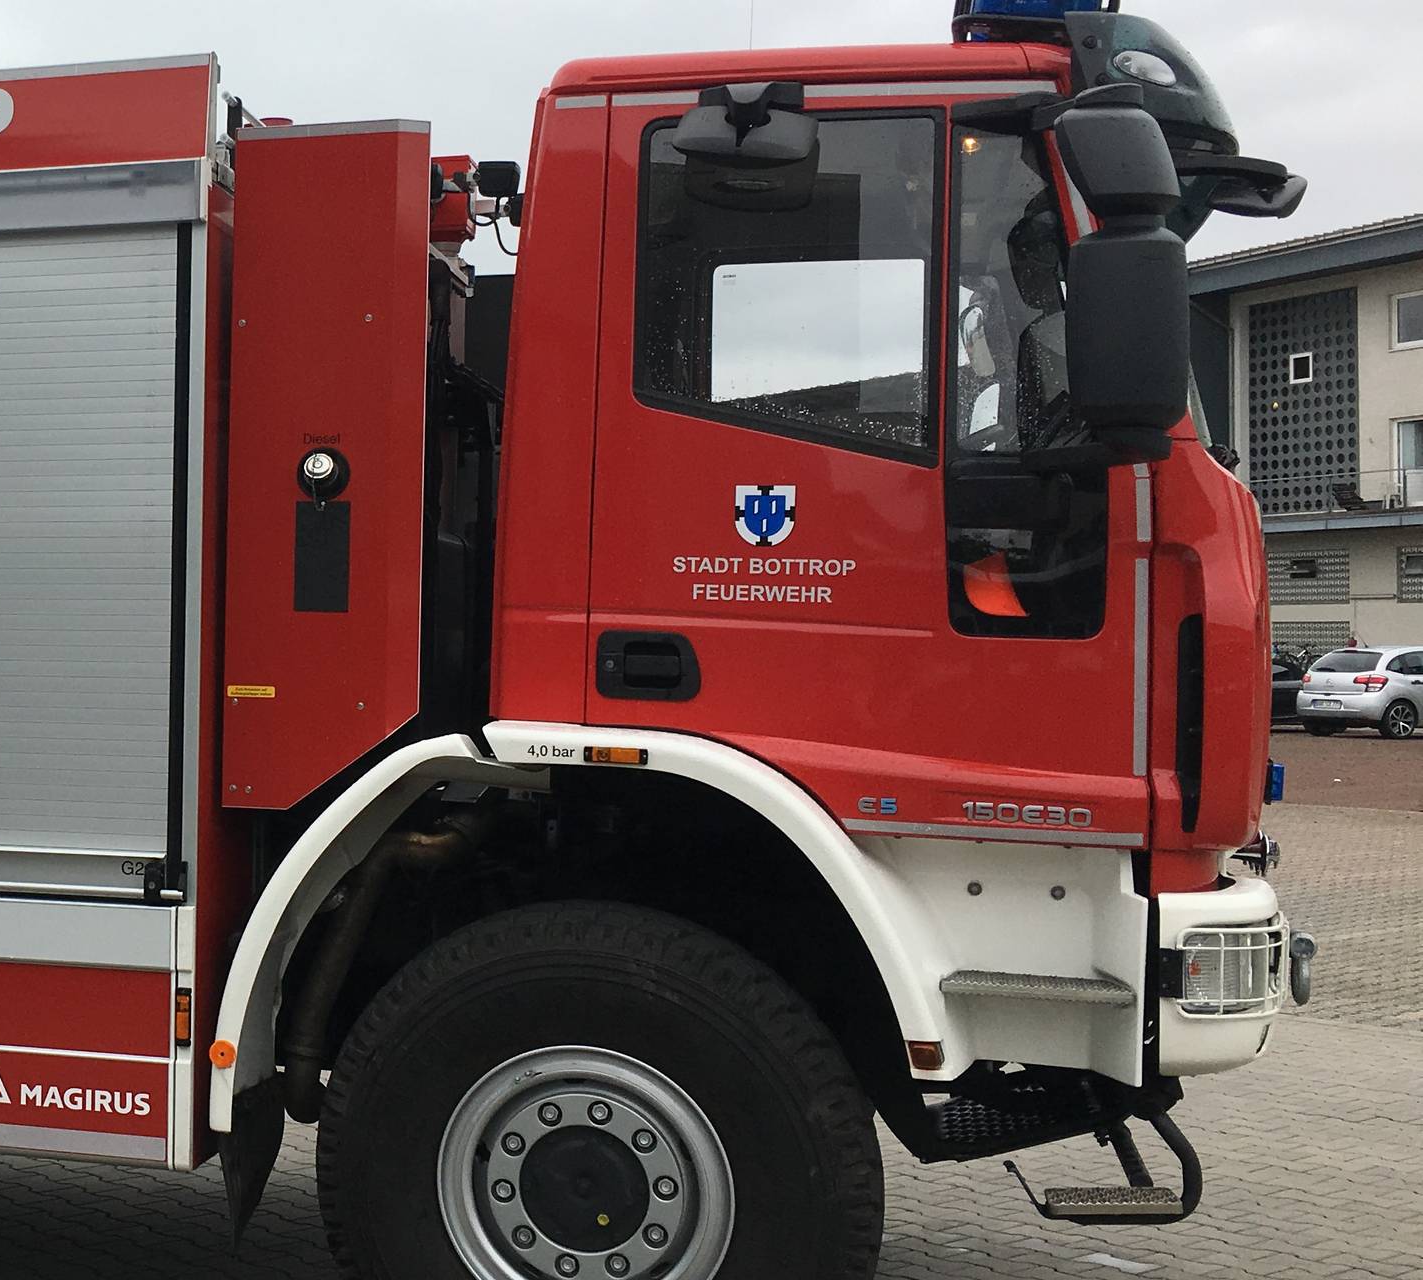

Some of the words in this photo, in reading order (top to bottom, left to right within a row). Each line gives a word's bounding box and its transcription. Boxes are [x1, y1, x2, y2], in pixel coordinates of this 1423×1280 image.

[303, 432, 341, 445] Diesel
[672, 556, 743, 574] STADT
[749, 558, 857, 577] BOTTROP
[692, 583, 833, 603] FEUERWEHR
[527, 744, 548, 758] 4,0
[552, 745, 576, 758] bar
[857, 796, 898, 815] E5
[962, 801, 1093, 827] 150E30
[121, 860, 145, 876] G2
[19, 1083, 152, 1117] MAGIRUS
